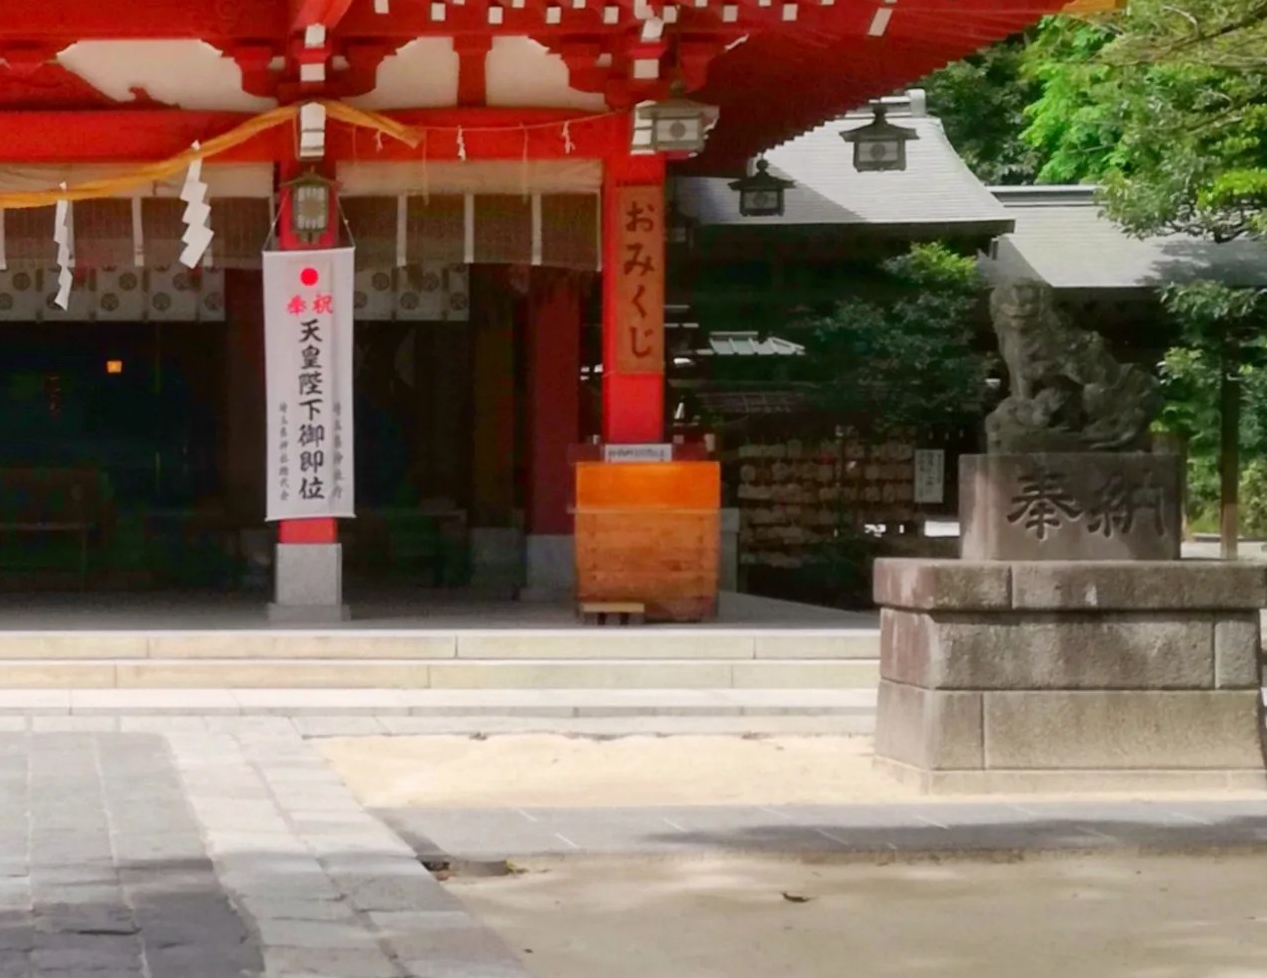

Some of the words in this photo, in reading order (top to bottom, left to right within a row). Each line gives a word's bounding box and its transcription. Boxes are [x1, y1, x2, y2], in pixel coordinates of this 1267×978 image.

[287, 294, 334, 317] 奉祝
[623, 201, 655, 358] おみくじ
[298, 318, 325, 500] 天皇陛下御即位
[1006, 466, 1166, 540] 奉納
